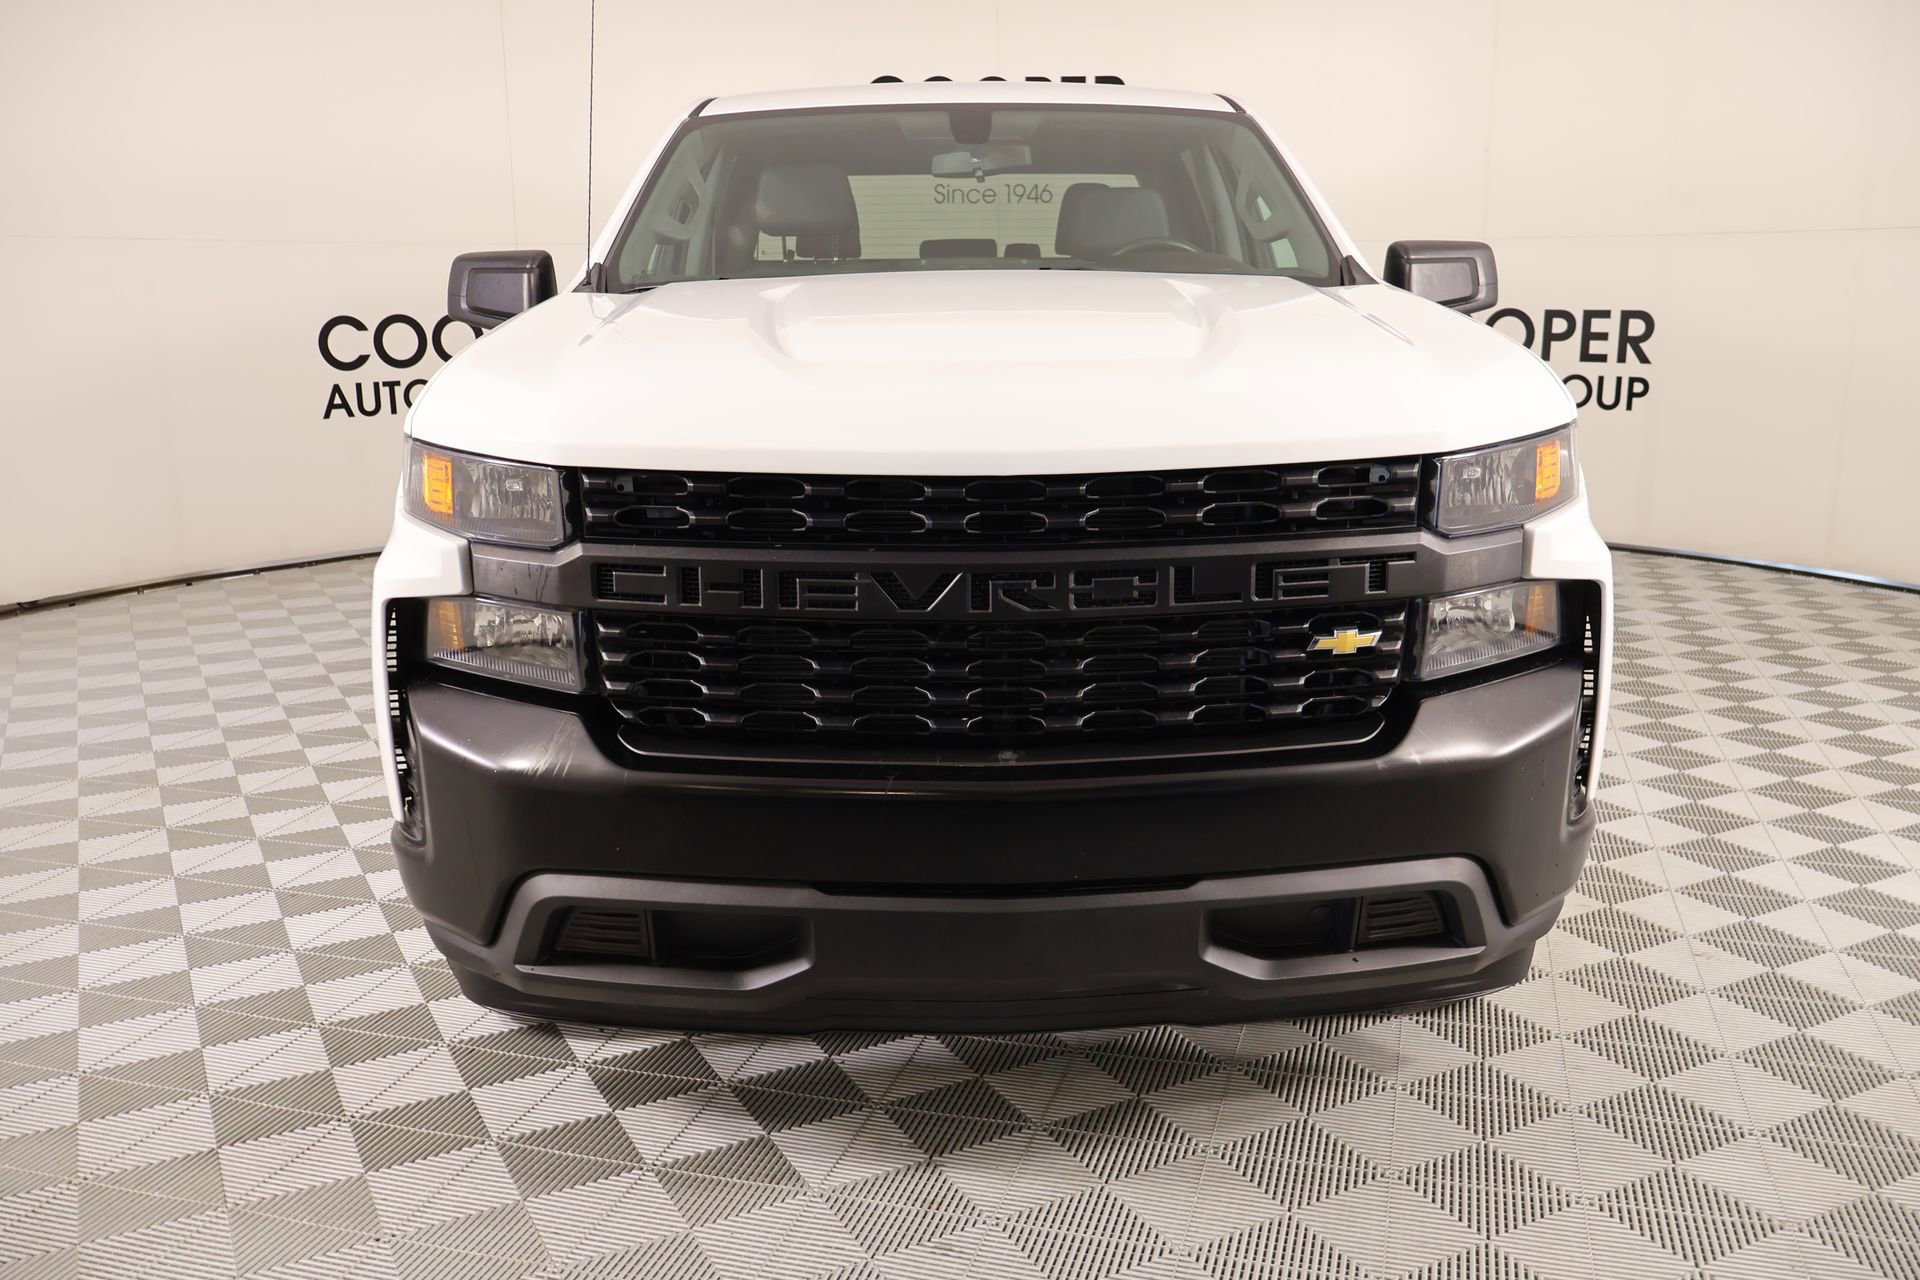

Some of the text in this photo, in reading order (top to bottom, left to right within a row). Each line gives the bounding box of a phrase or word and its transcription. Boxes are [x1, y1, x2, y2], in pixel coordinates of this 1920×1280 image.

[934, 183, 1053, 204] Since 1946
[318, 314, 484, 371] COO
[1486, 308, 1655, 364] OPER
[1563, 374, 1650, 411] OUP
[591, 551, 1417, 613] CHEVROLET
